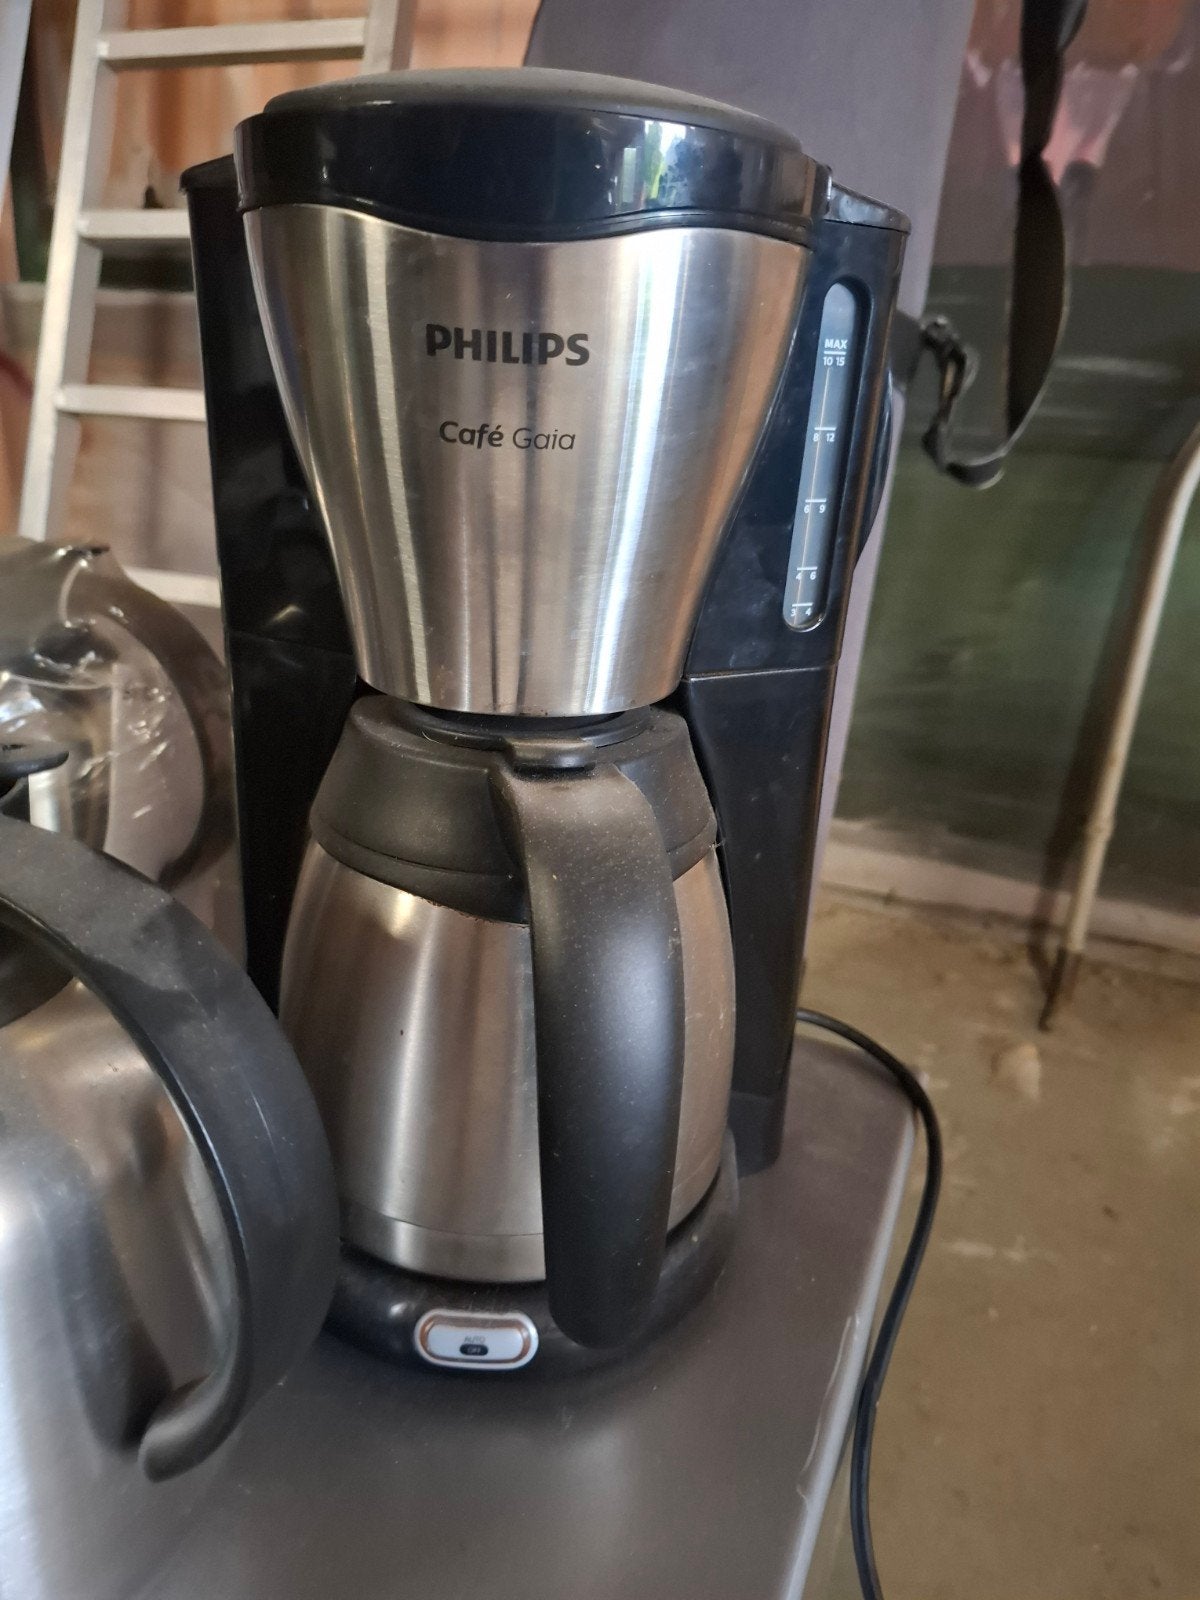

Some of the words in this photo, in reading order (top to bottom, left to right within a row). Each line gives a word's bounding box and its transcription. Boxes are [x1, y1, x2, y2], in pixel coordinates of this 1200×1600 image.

[425, 323, 590, 366] PHILIPS
[824, 338, 848, 349] MAX
[823, 356, 833, 366] 10
[836, 356, 845, 366] 15
[439, 420, 504, 449] Café
[512, 427, 576, 450] Gaia
[813, 433, 819, 442] 8
[826, 433, 835, 442] 12
[804, 505, 810, 514] 6
[819, 505, 826, 514] 9
[810, 571, 816, 580] 6
[805, 607, 811, 616] 4
